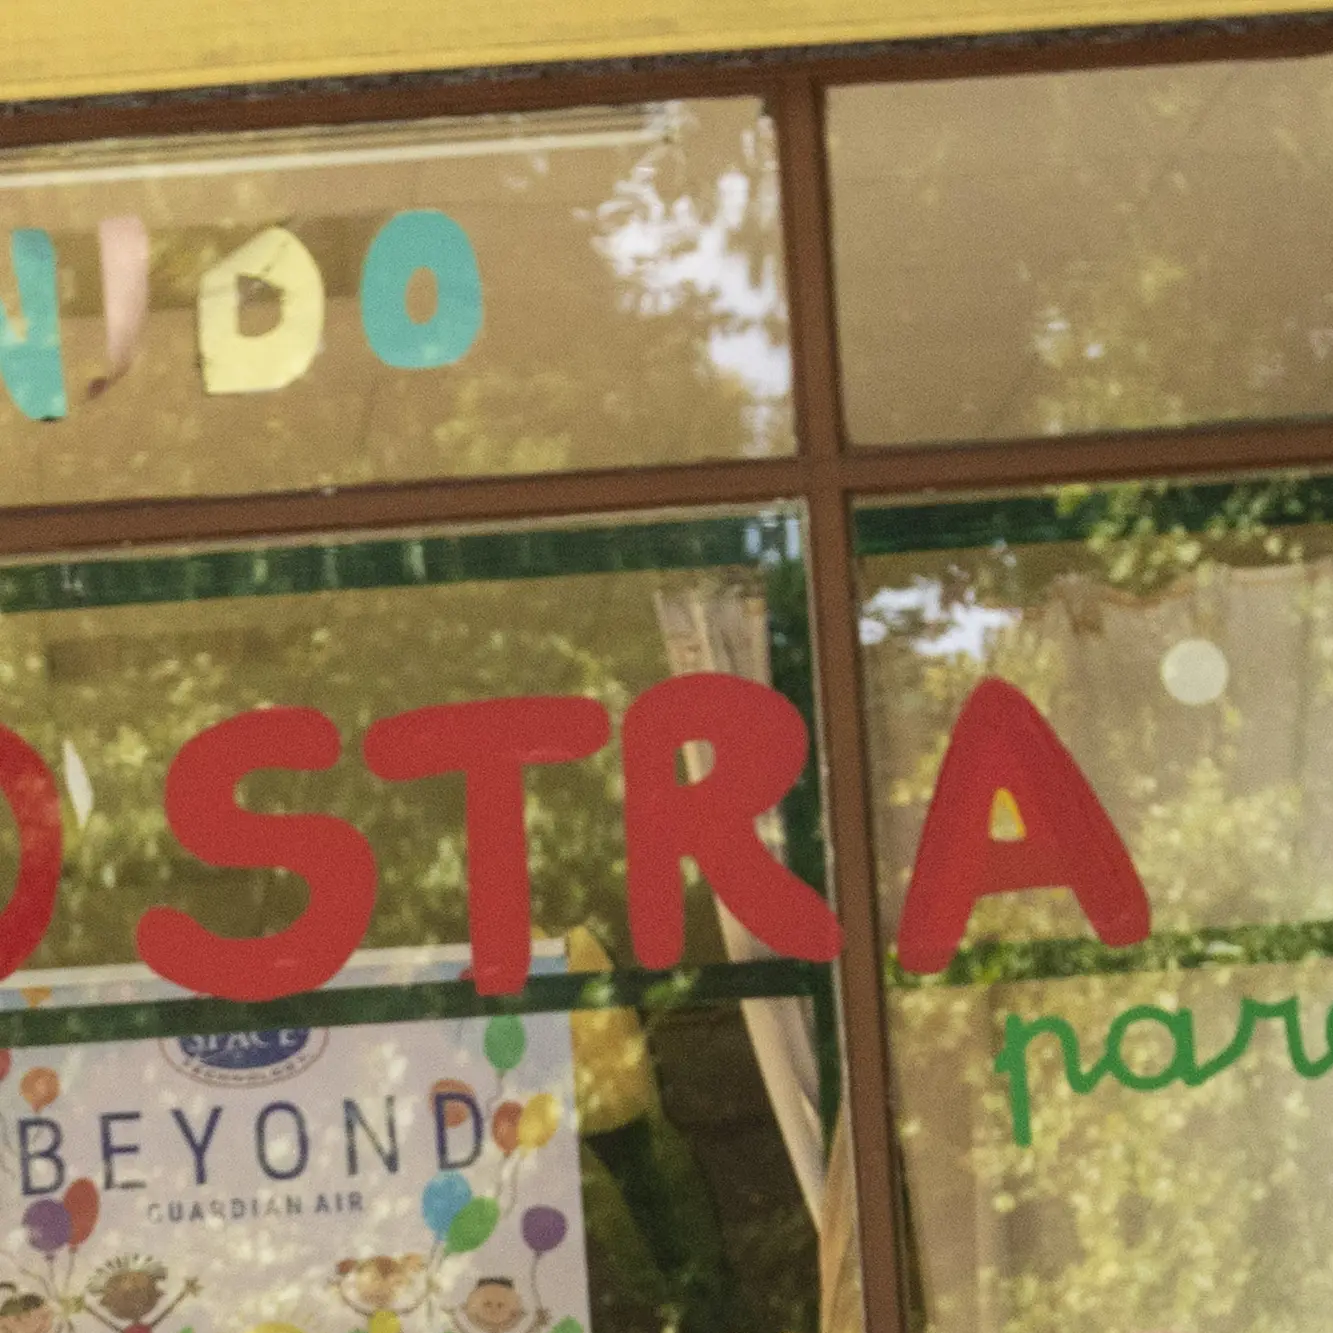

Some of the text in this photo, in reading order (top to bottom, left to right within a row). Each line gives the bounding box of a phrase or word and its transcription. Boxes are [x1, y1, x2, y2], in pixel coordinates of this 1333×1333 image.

[0, 672, 1152, 1001] STRA
[18, 1092, 483, 1196] BEYOND
[147, 1190, 363, 1224] GUARDIAN AIR
